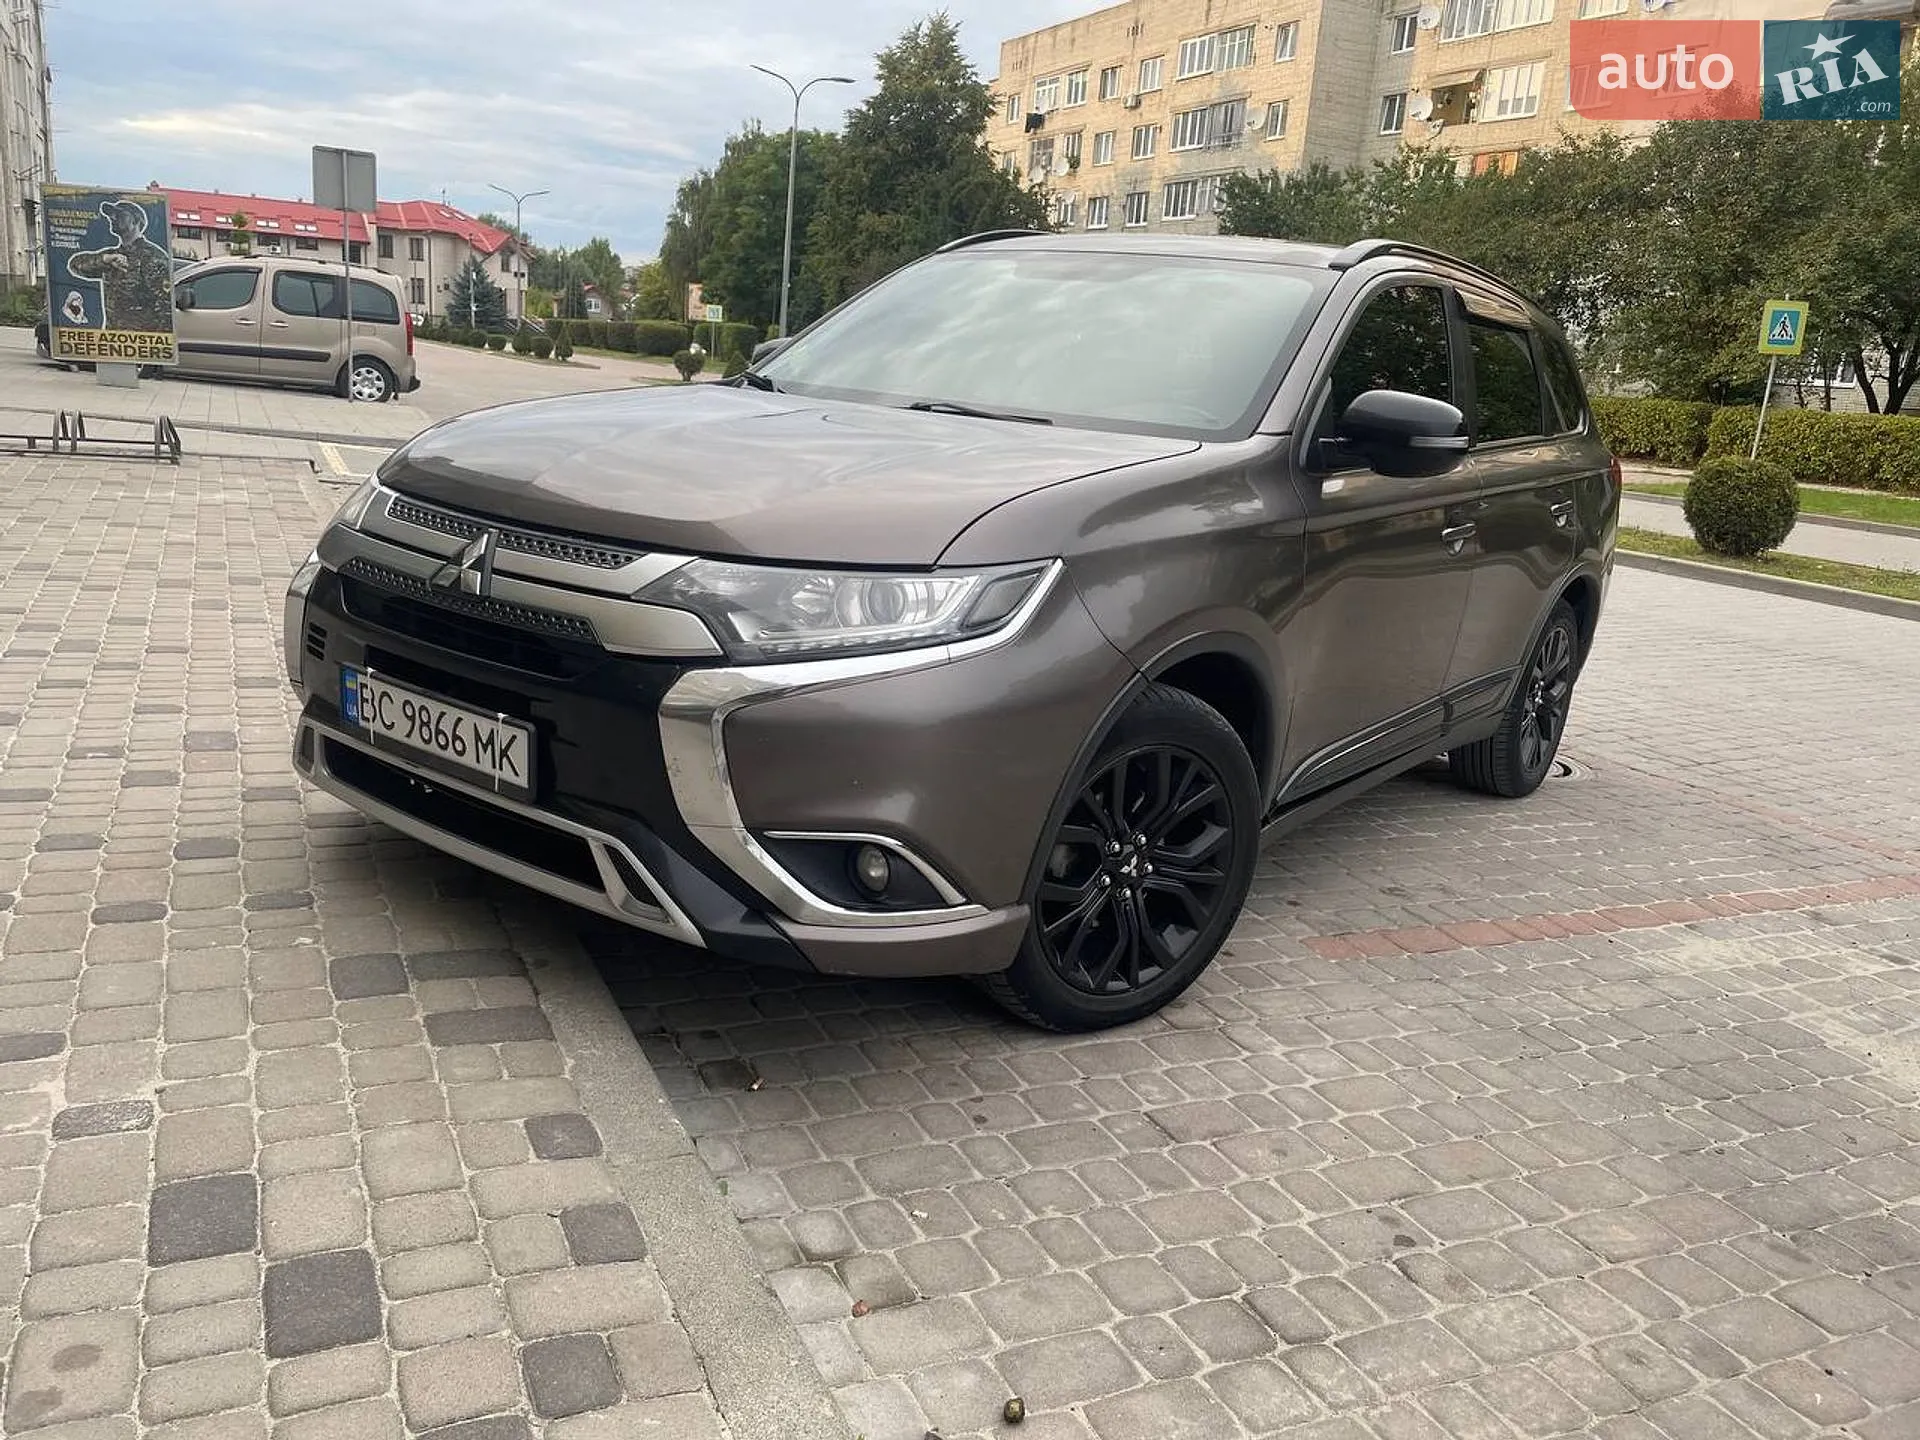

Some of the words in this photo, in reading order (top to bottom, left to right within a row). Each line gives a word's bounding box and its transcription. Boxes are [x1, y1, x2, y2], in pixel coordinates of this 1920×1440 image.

[58, 330, 95, 342] FREE
[100, 333, 172, 346] AZOVSTAL
[60, 341, 173, 359] DEFENDERS
[360, 682, 395, 730] BC
[402, 699, 467, 757] 9866
[474, 723, 519, 776] MK
